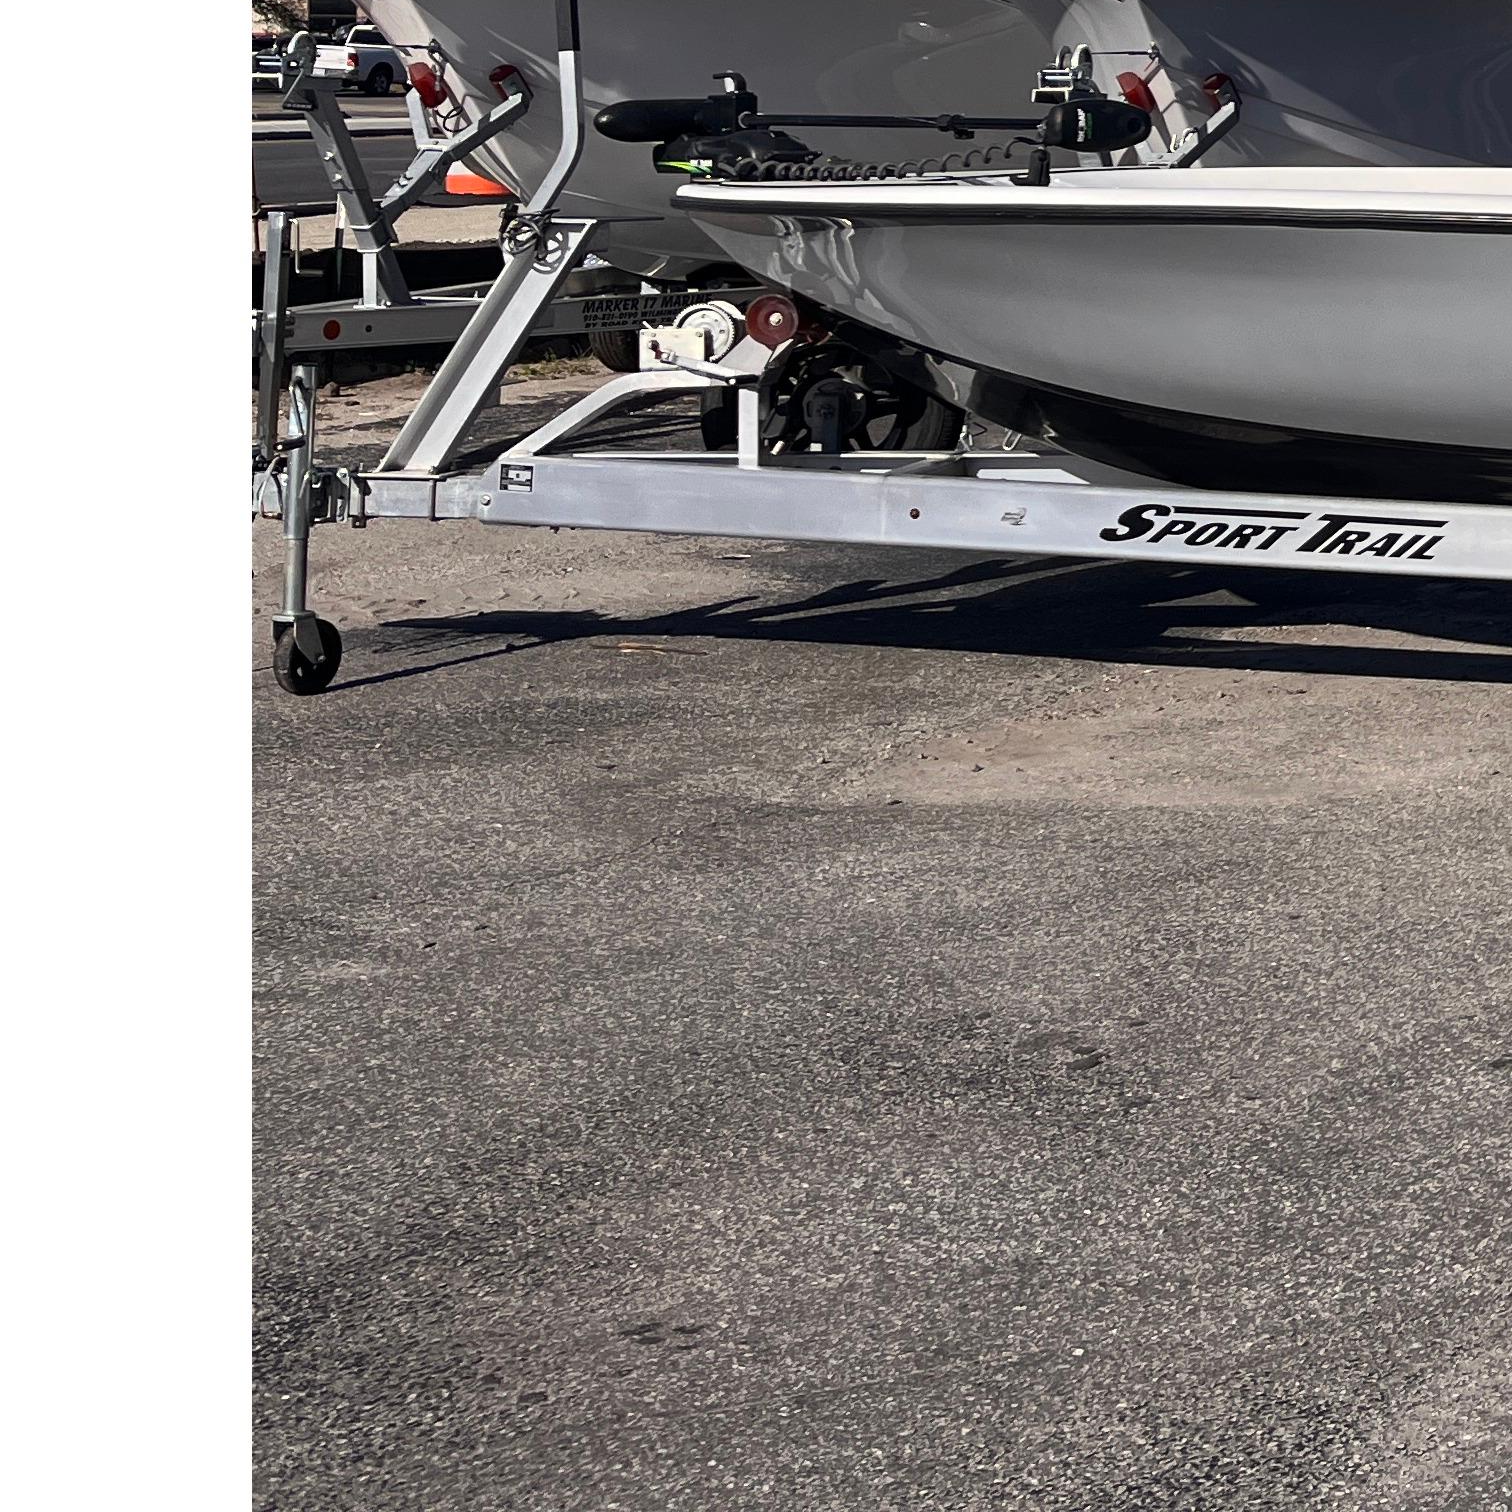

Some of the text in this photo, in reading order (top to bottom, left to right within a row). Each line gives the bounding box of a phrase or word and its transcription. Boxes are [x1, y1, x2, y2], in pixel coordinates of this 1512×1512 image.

[582, 297, 640, 314] MARKER
[1099, 503, 1449, 561] SPORT TRAIL
